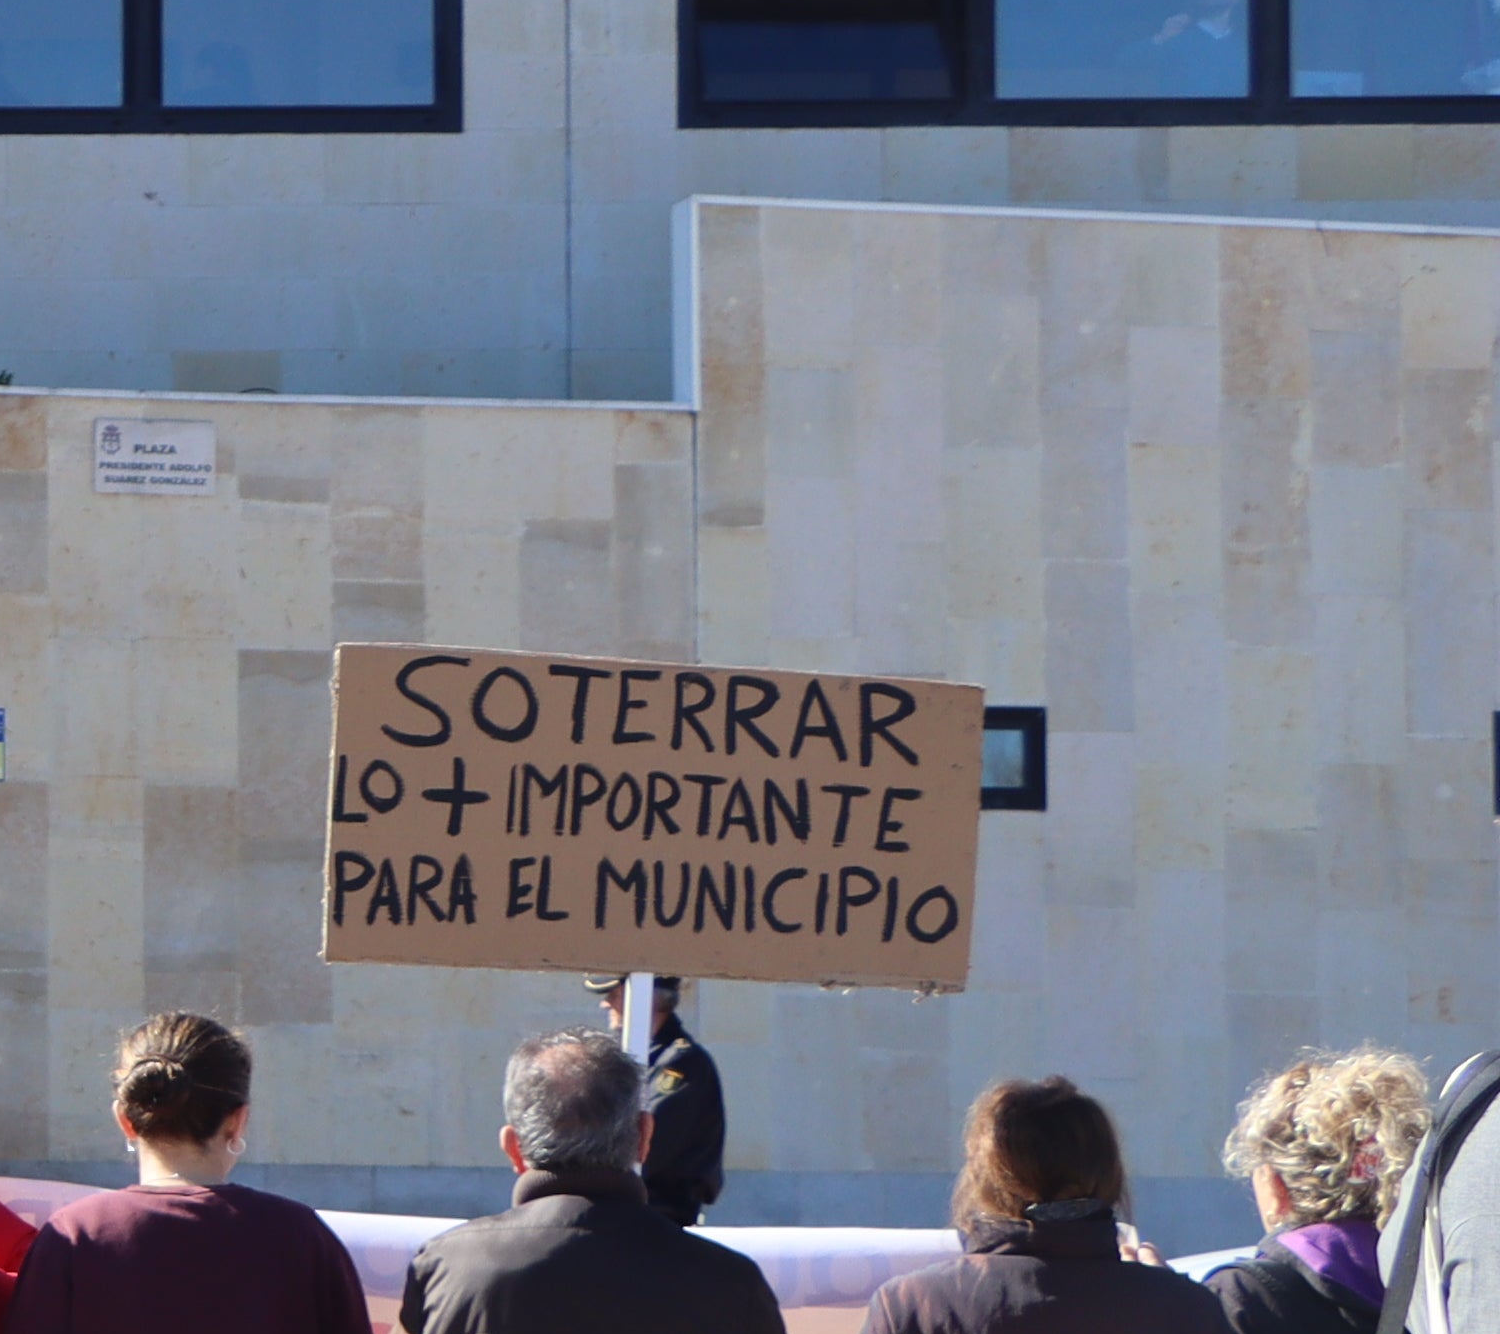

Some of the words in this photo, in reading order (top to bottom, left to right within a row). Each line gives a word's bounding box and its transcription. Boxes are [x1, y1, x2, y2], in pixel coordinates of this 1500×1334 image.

[133, 443, 177, 455] PLAZA
[169, 463, 213, 473] ADOLFO
[380, 653, 919, 767] SOTERRAR
[330, 753, 405, 824] LO
[421, 756, 491, 836] +
[505, 762, 924, 853] IMPORTANTE
[331, 851, 478, 927] PARA
[506, 856, 571, 921] EL
[593, 858, 960, 945] MUNICIPIO
